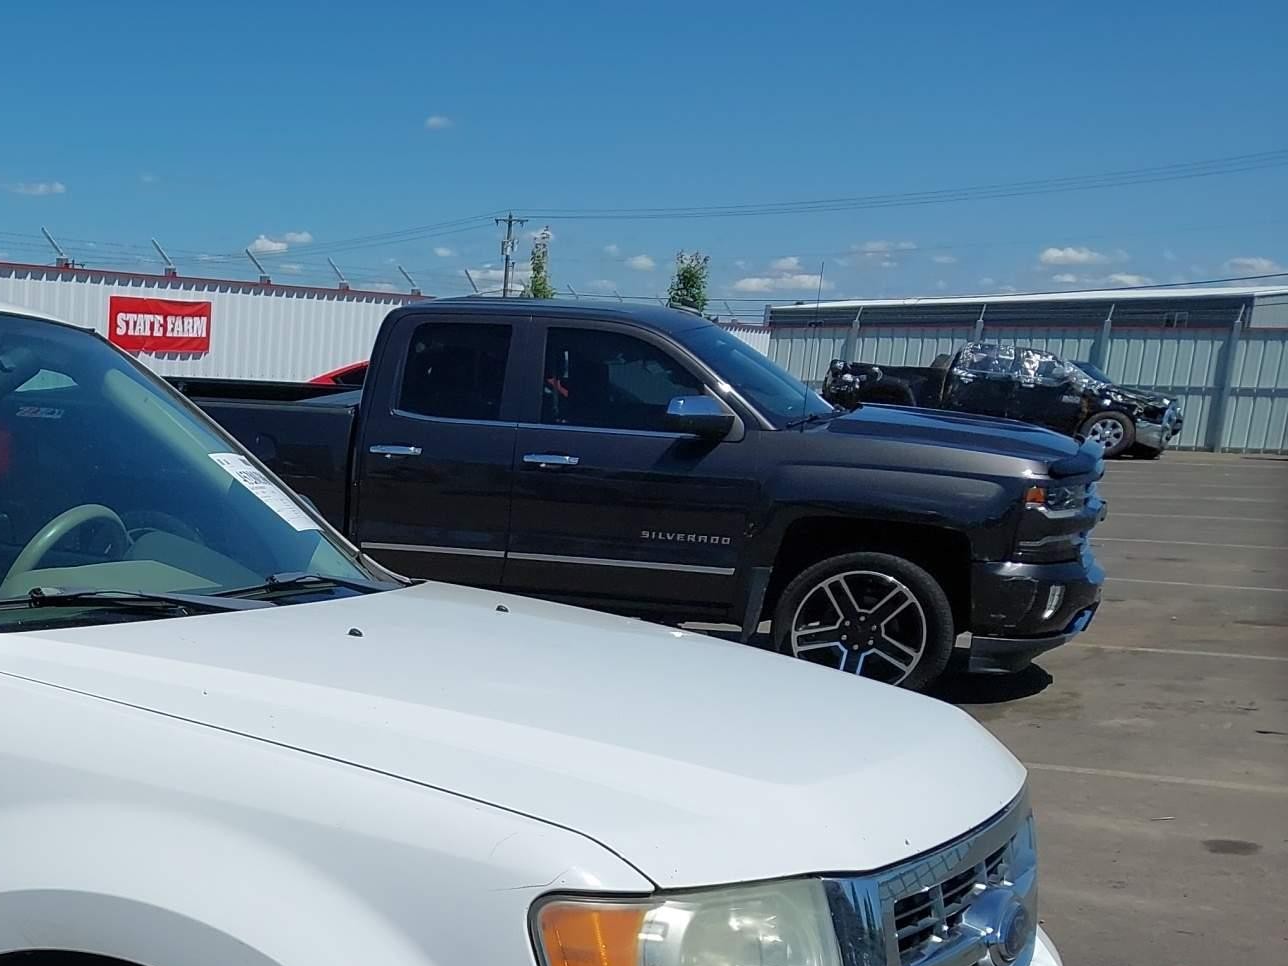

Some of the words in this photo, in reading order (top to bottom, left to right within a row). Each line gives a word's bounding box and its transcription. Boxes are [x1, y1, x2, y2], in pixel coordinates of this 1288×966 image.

[116, 312, 163, 337] STATE
[165, 315, 207, 338] FARM
[640, 530, 731, 545] SILVERADO
